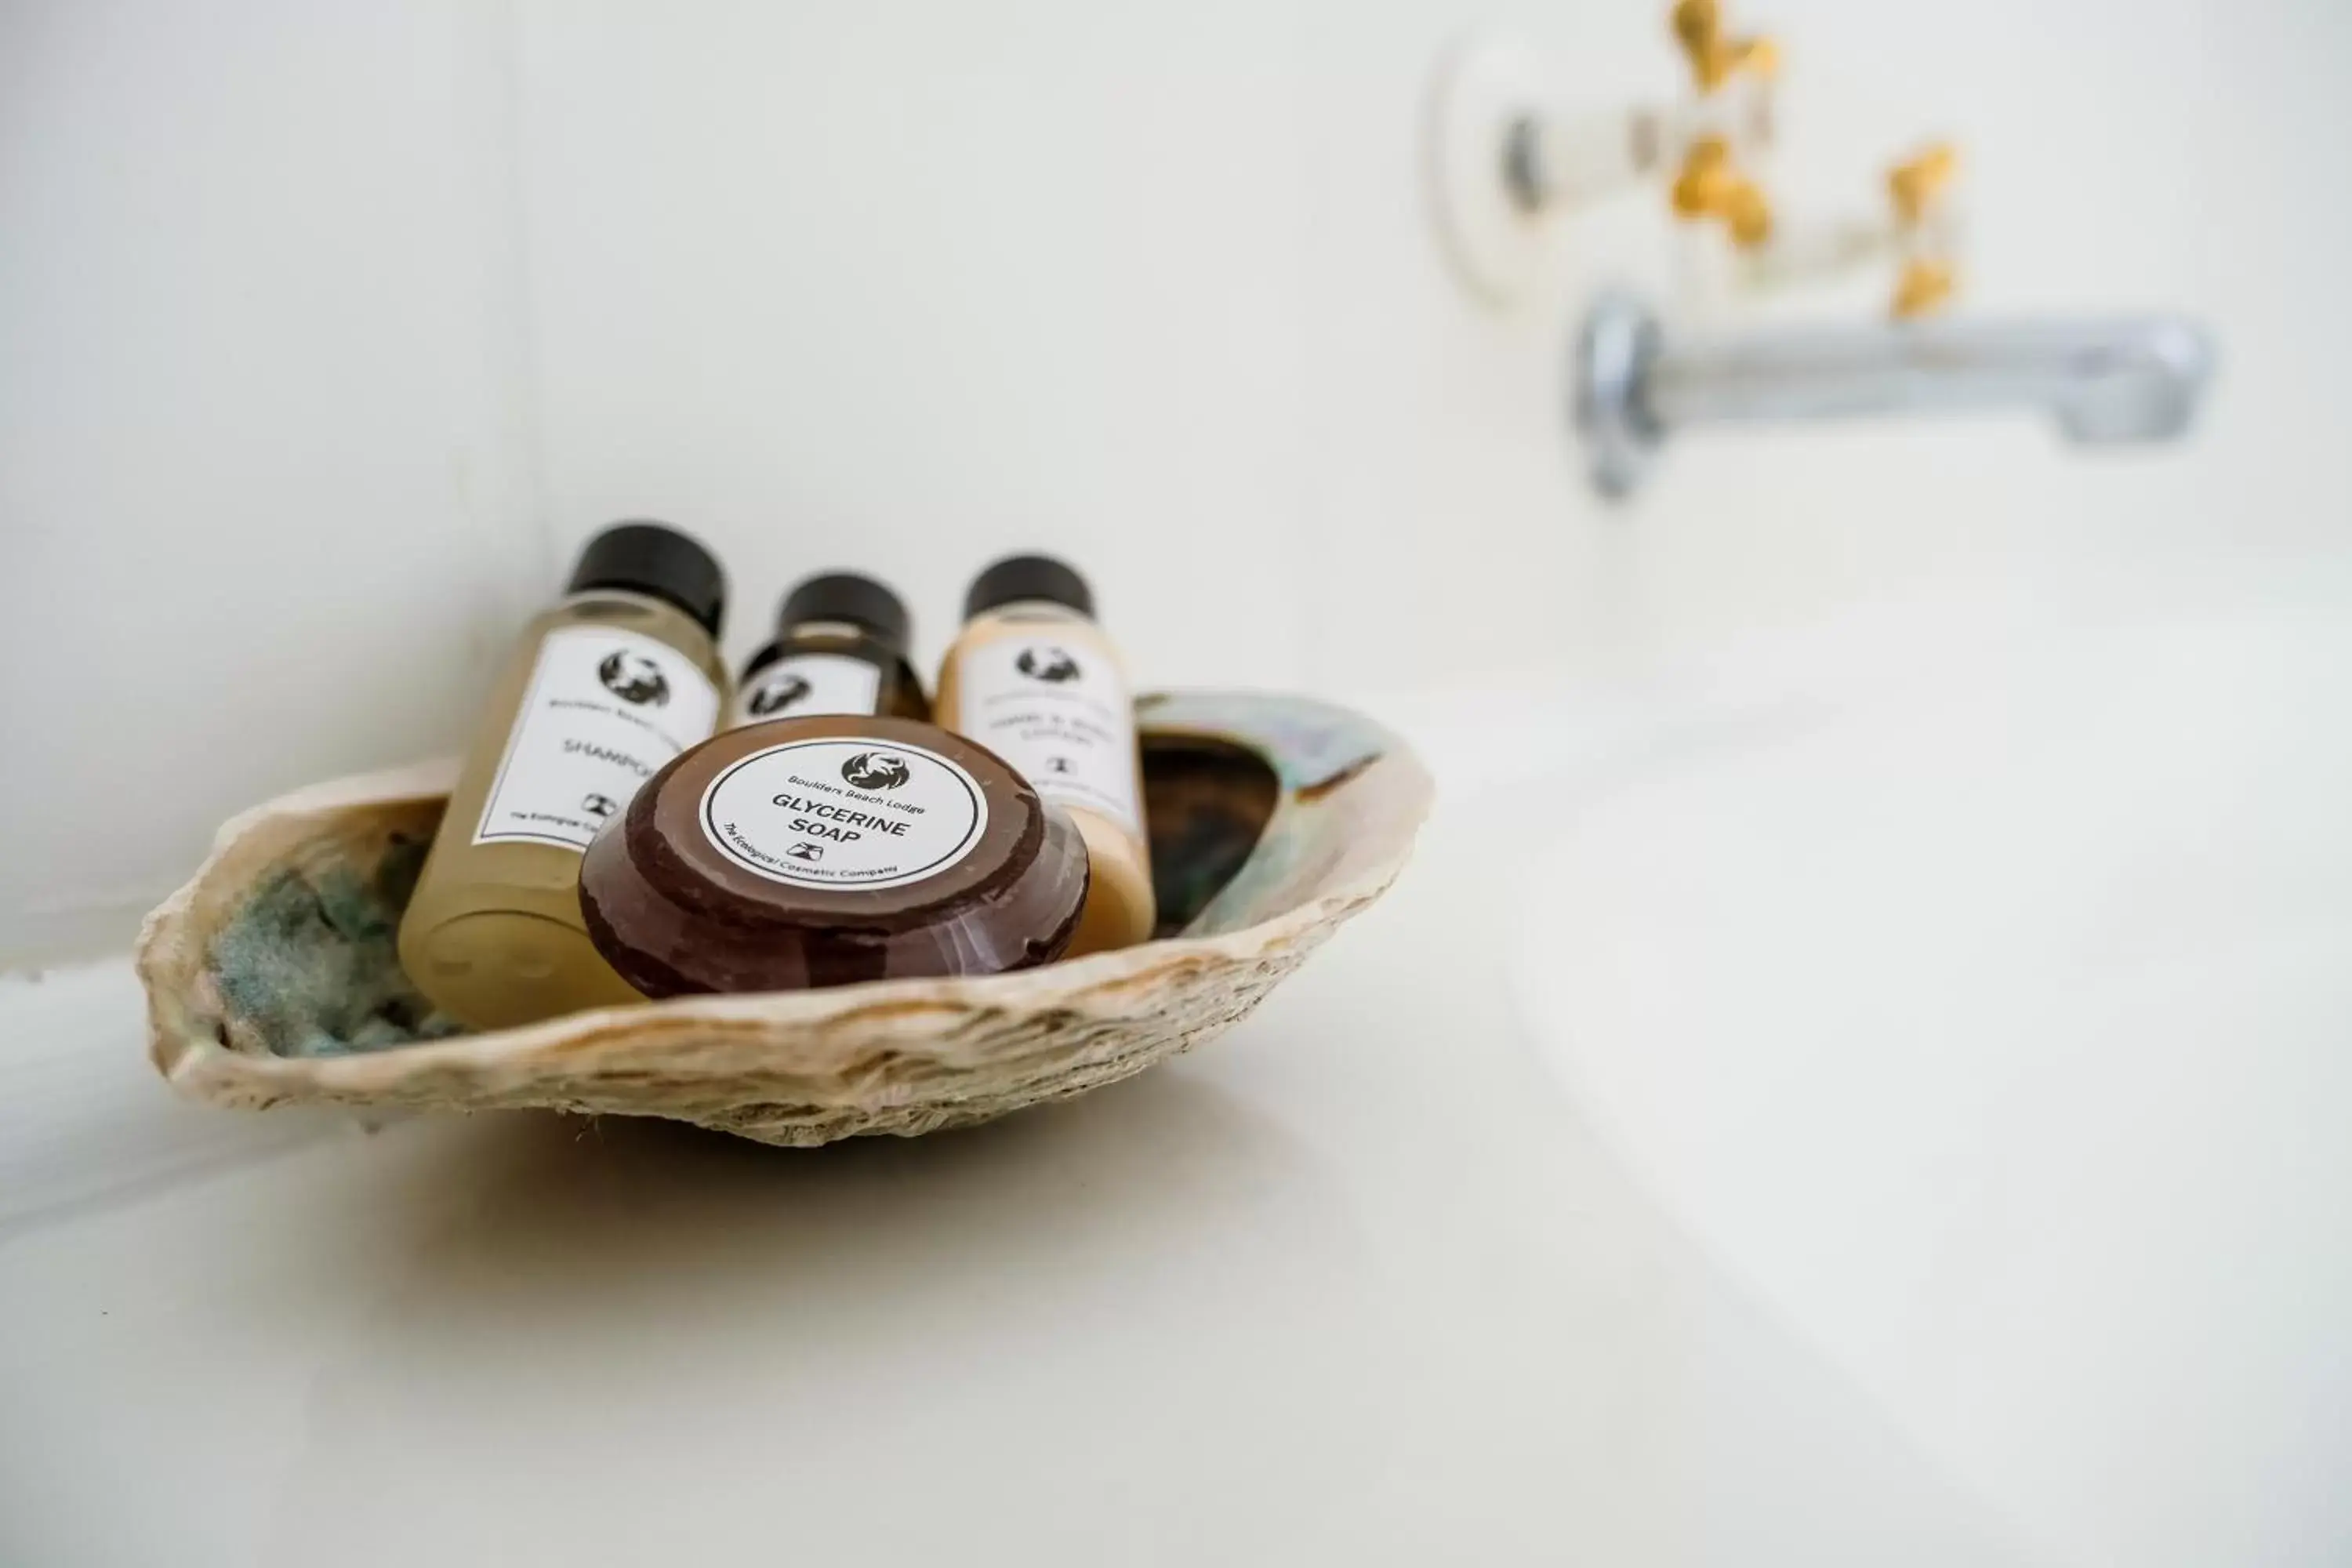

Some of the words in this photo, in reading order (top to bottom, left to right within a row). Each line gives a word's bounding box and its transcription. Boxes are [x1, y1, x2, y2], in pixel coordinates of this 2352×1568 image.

[564, 737, 655, 777] SHAMPO
[772, 793, 912, 837] GLYCERINE
[787, 775, 843, 796] Boulders
[845, 789, 884, 806] Beach
[887, 798, 925, 815] Lodge
[724, 822, 738, 837] The
[732, 835, 781, 865] Ecological
[780, 862, 835, 877] Cosmetic
[840, 866, 898, 878] Company
[788, 818, 862, 844] SOAP
